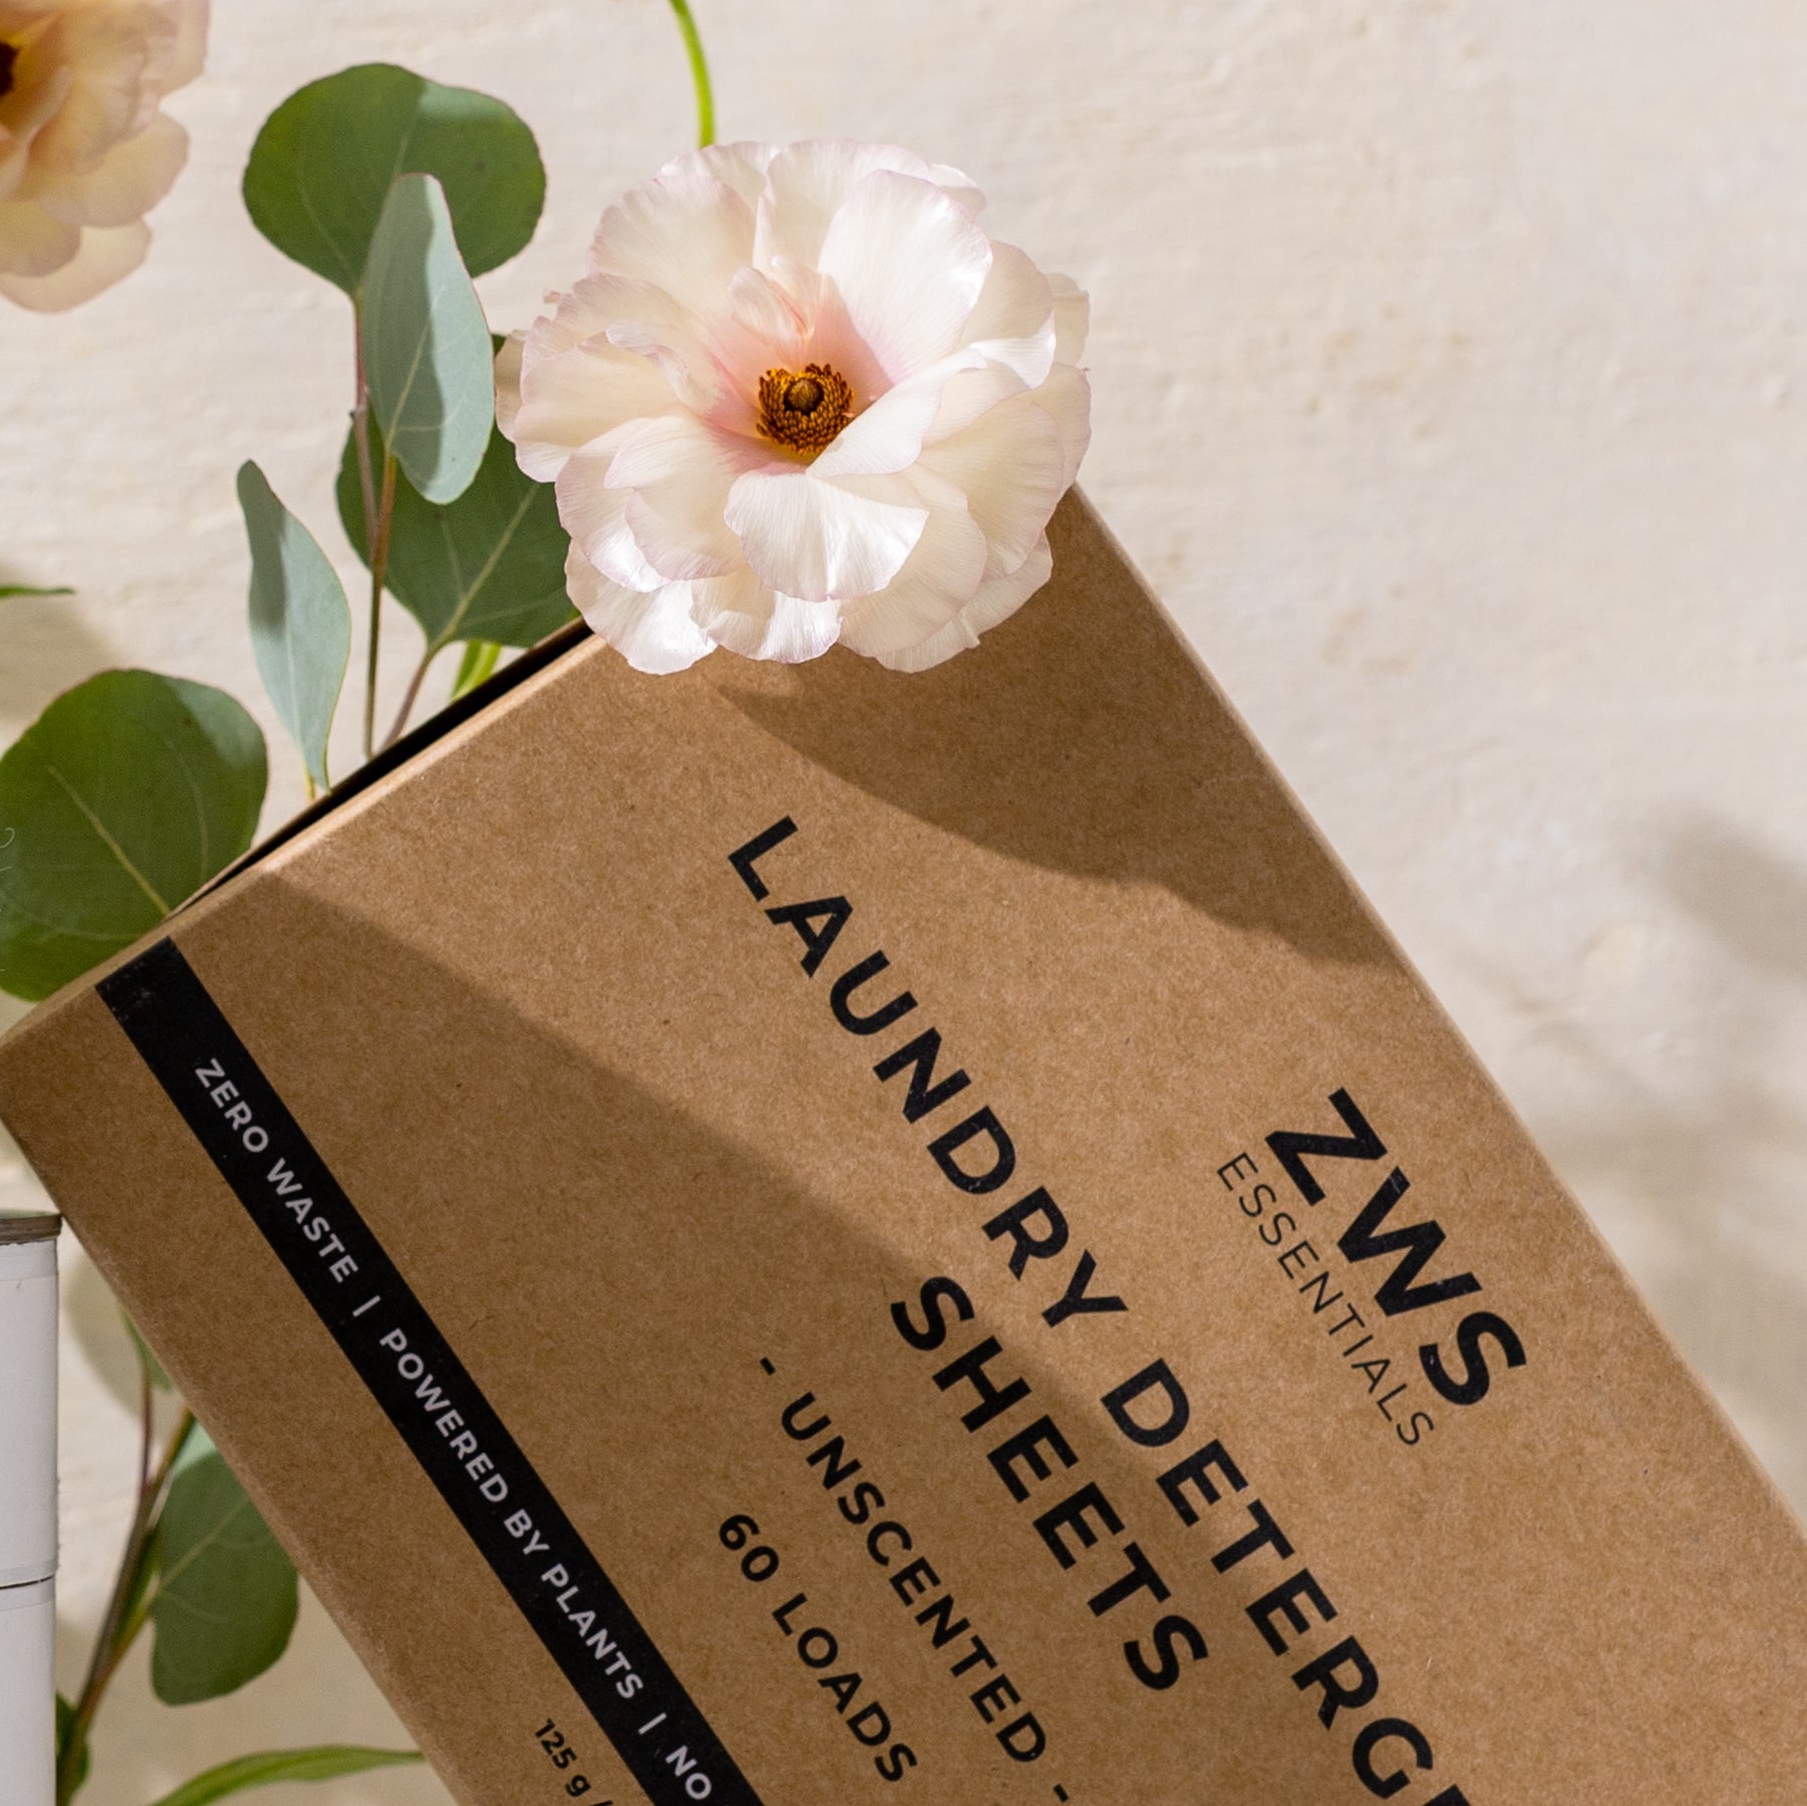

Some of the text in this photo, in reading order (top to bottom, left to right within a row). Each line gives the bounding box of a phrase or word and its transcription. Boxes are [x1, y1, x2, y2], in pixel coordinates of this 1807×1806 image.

[727, 815, 1129, 1328] LAUNDRY
[1216, 1151, 1435, 1446] ESSENTIALS
[1264, 1087, 1528, 1406] ZWS
[195, 1059, 268, 1152] ZERO
[267, 1158, 358, 1282] WASTE
[380, 1326, 508, 1502] POWERED
[504, 1509, 549, 1554] BY
[539, 1562, 643, 1698] PLANTS
[665, 1745, 711, 1799] NO
[780, 1390, 1048, 1764] UNSCENTED
[890, 1276, 1209, 1692] SHEETS
[534, 1717, 578, 1770] 125
[564, 1774, 592, 1798] g
[717, 1513, 919, 1783] 60 LOADS
